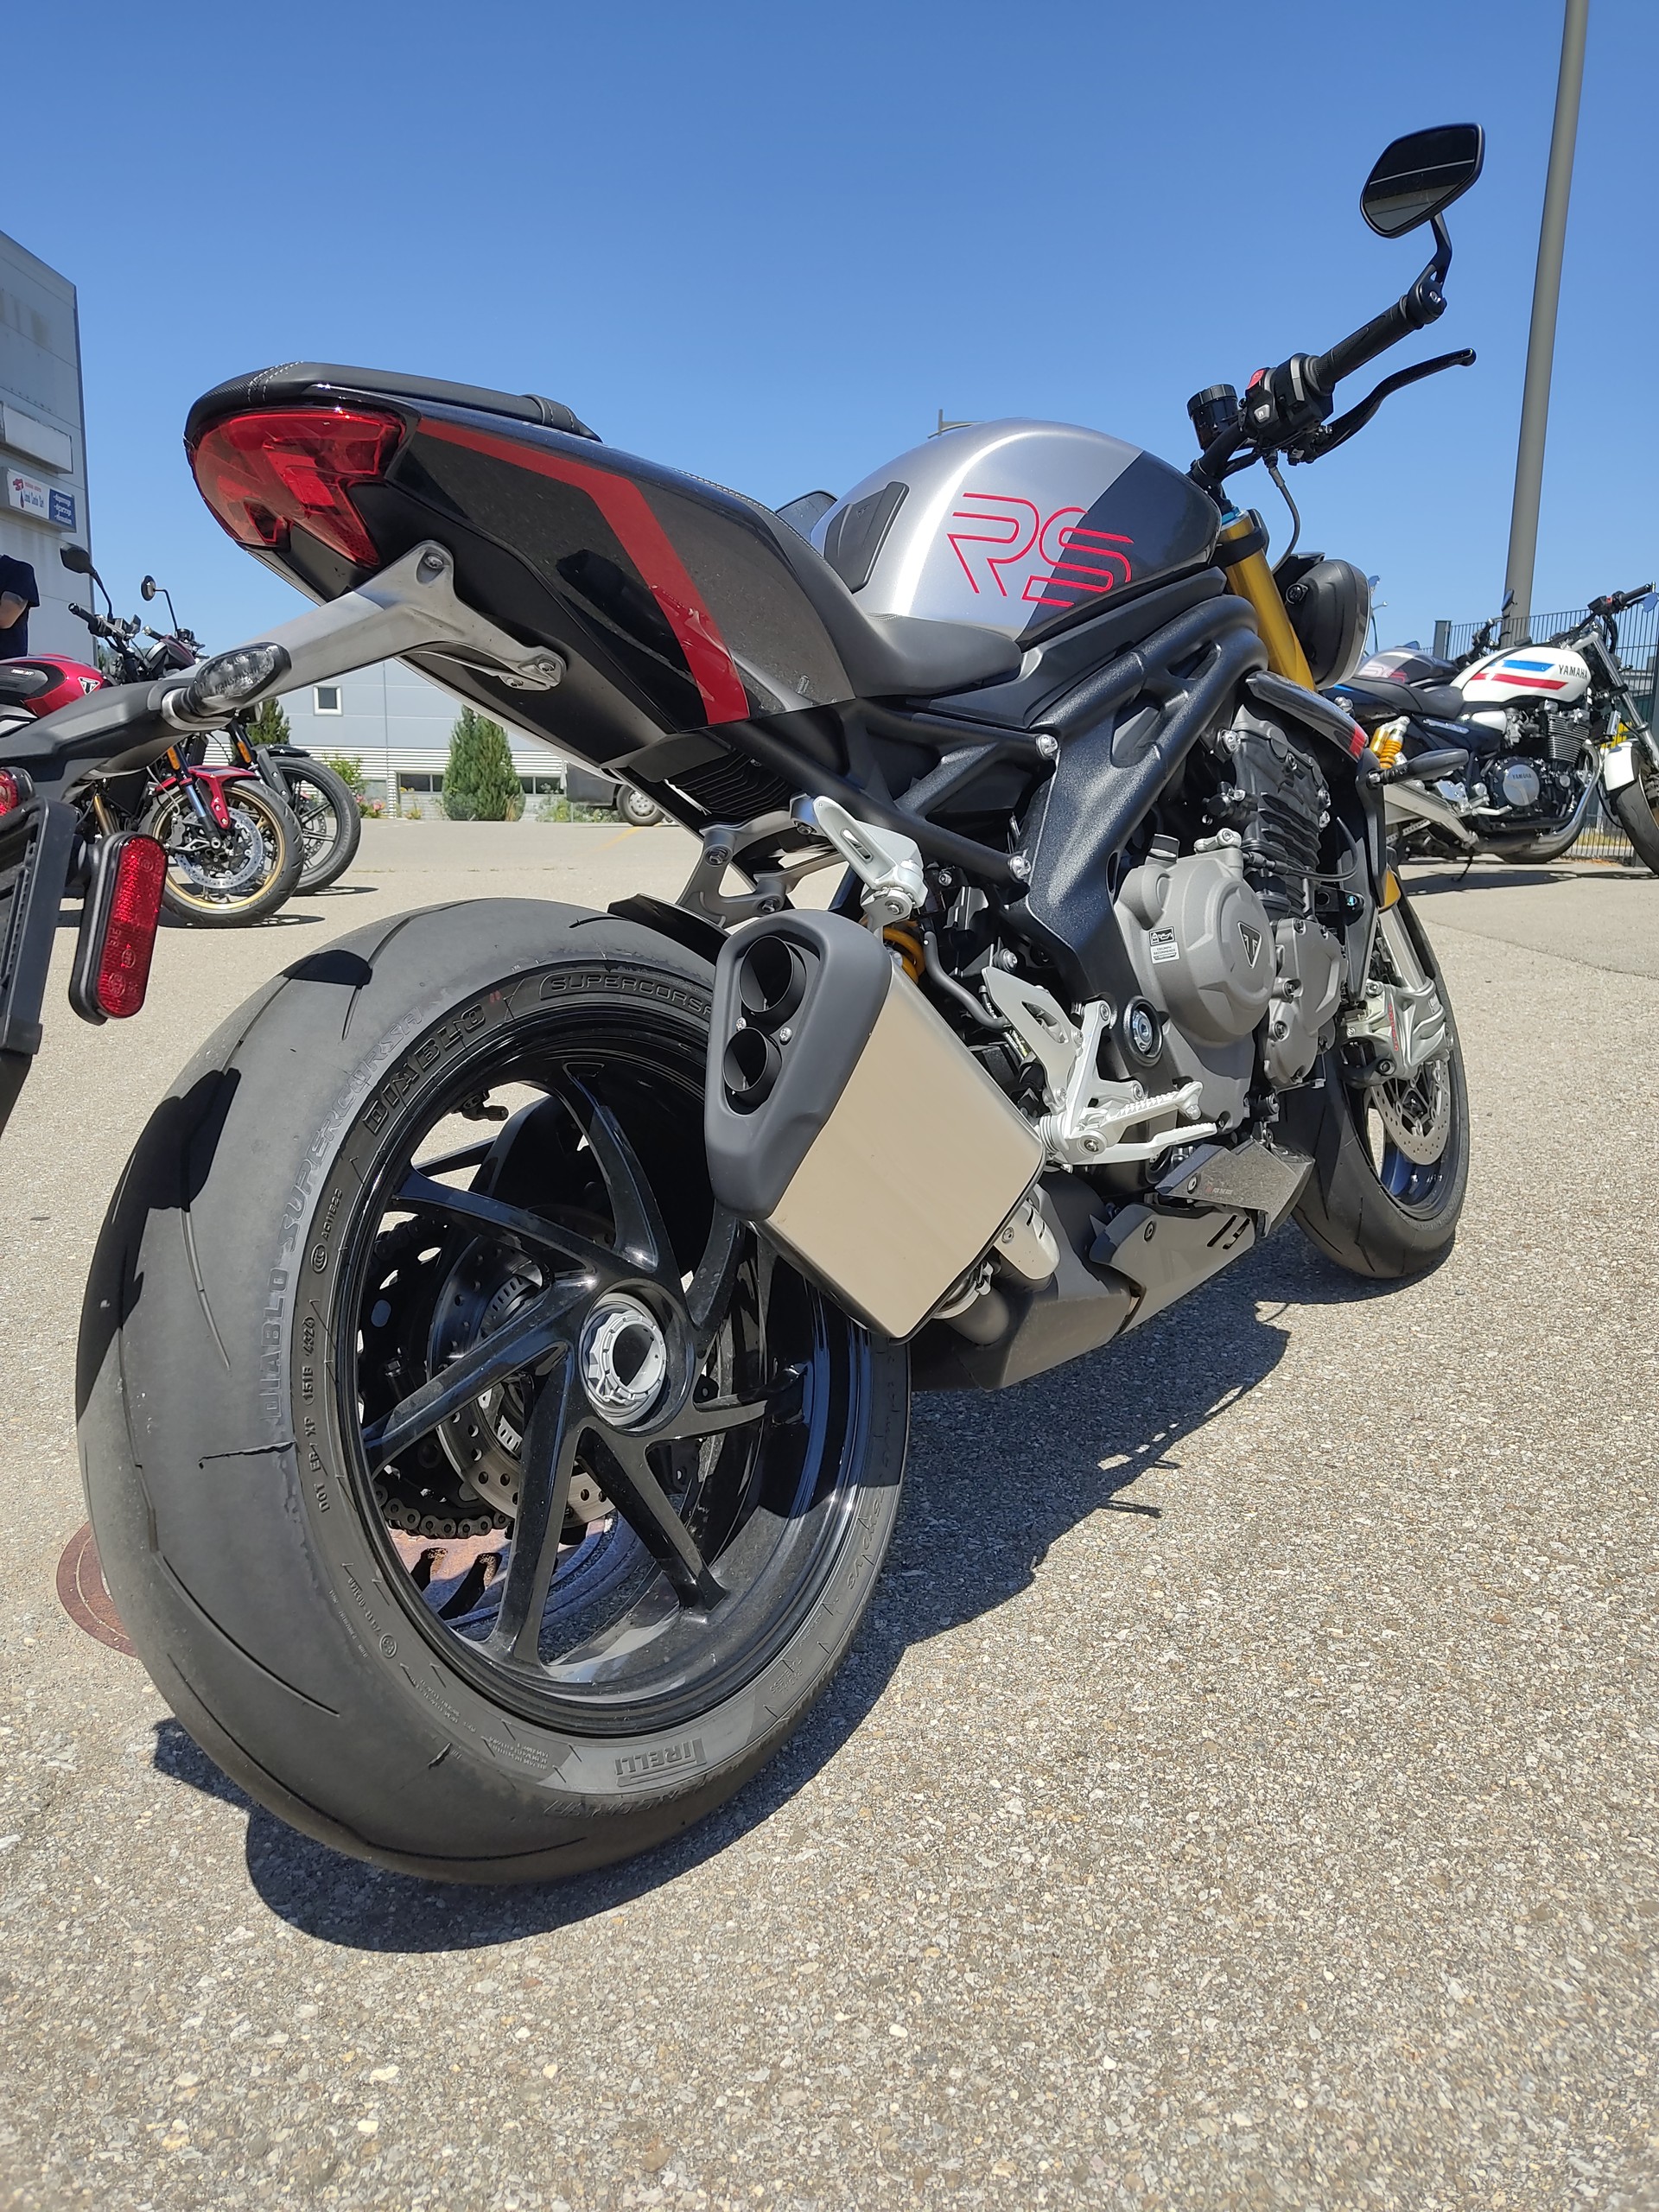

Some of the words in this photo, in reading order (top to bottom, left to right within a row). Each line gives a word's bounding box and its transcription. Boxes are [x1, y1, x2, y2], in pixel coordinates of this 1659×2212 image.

[946, 492, 1135, 607] RS
[1559, 664, 1588, 679] YAMAHA
[362, 1003, 486, 1137] DIABLO
[258, 1267, 289, 1421] DIABLO
[277, 1006, 424, 1254] SUPERCORSA
[304, 1416, 317, 1437] XP
[314, 1483, 330, 1513] DOT
[613, 1738, 707, 1788] PIRELLI
